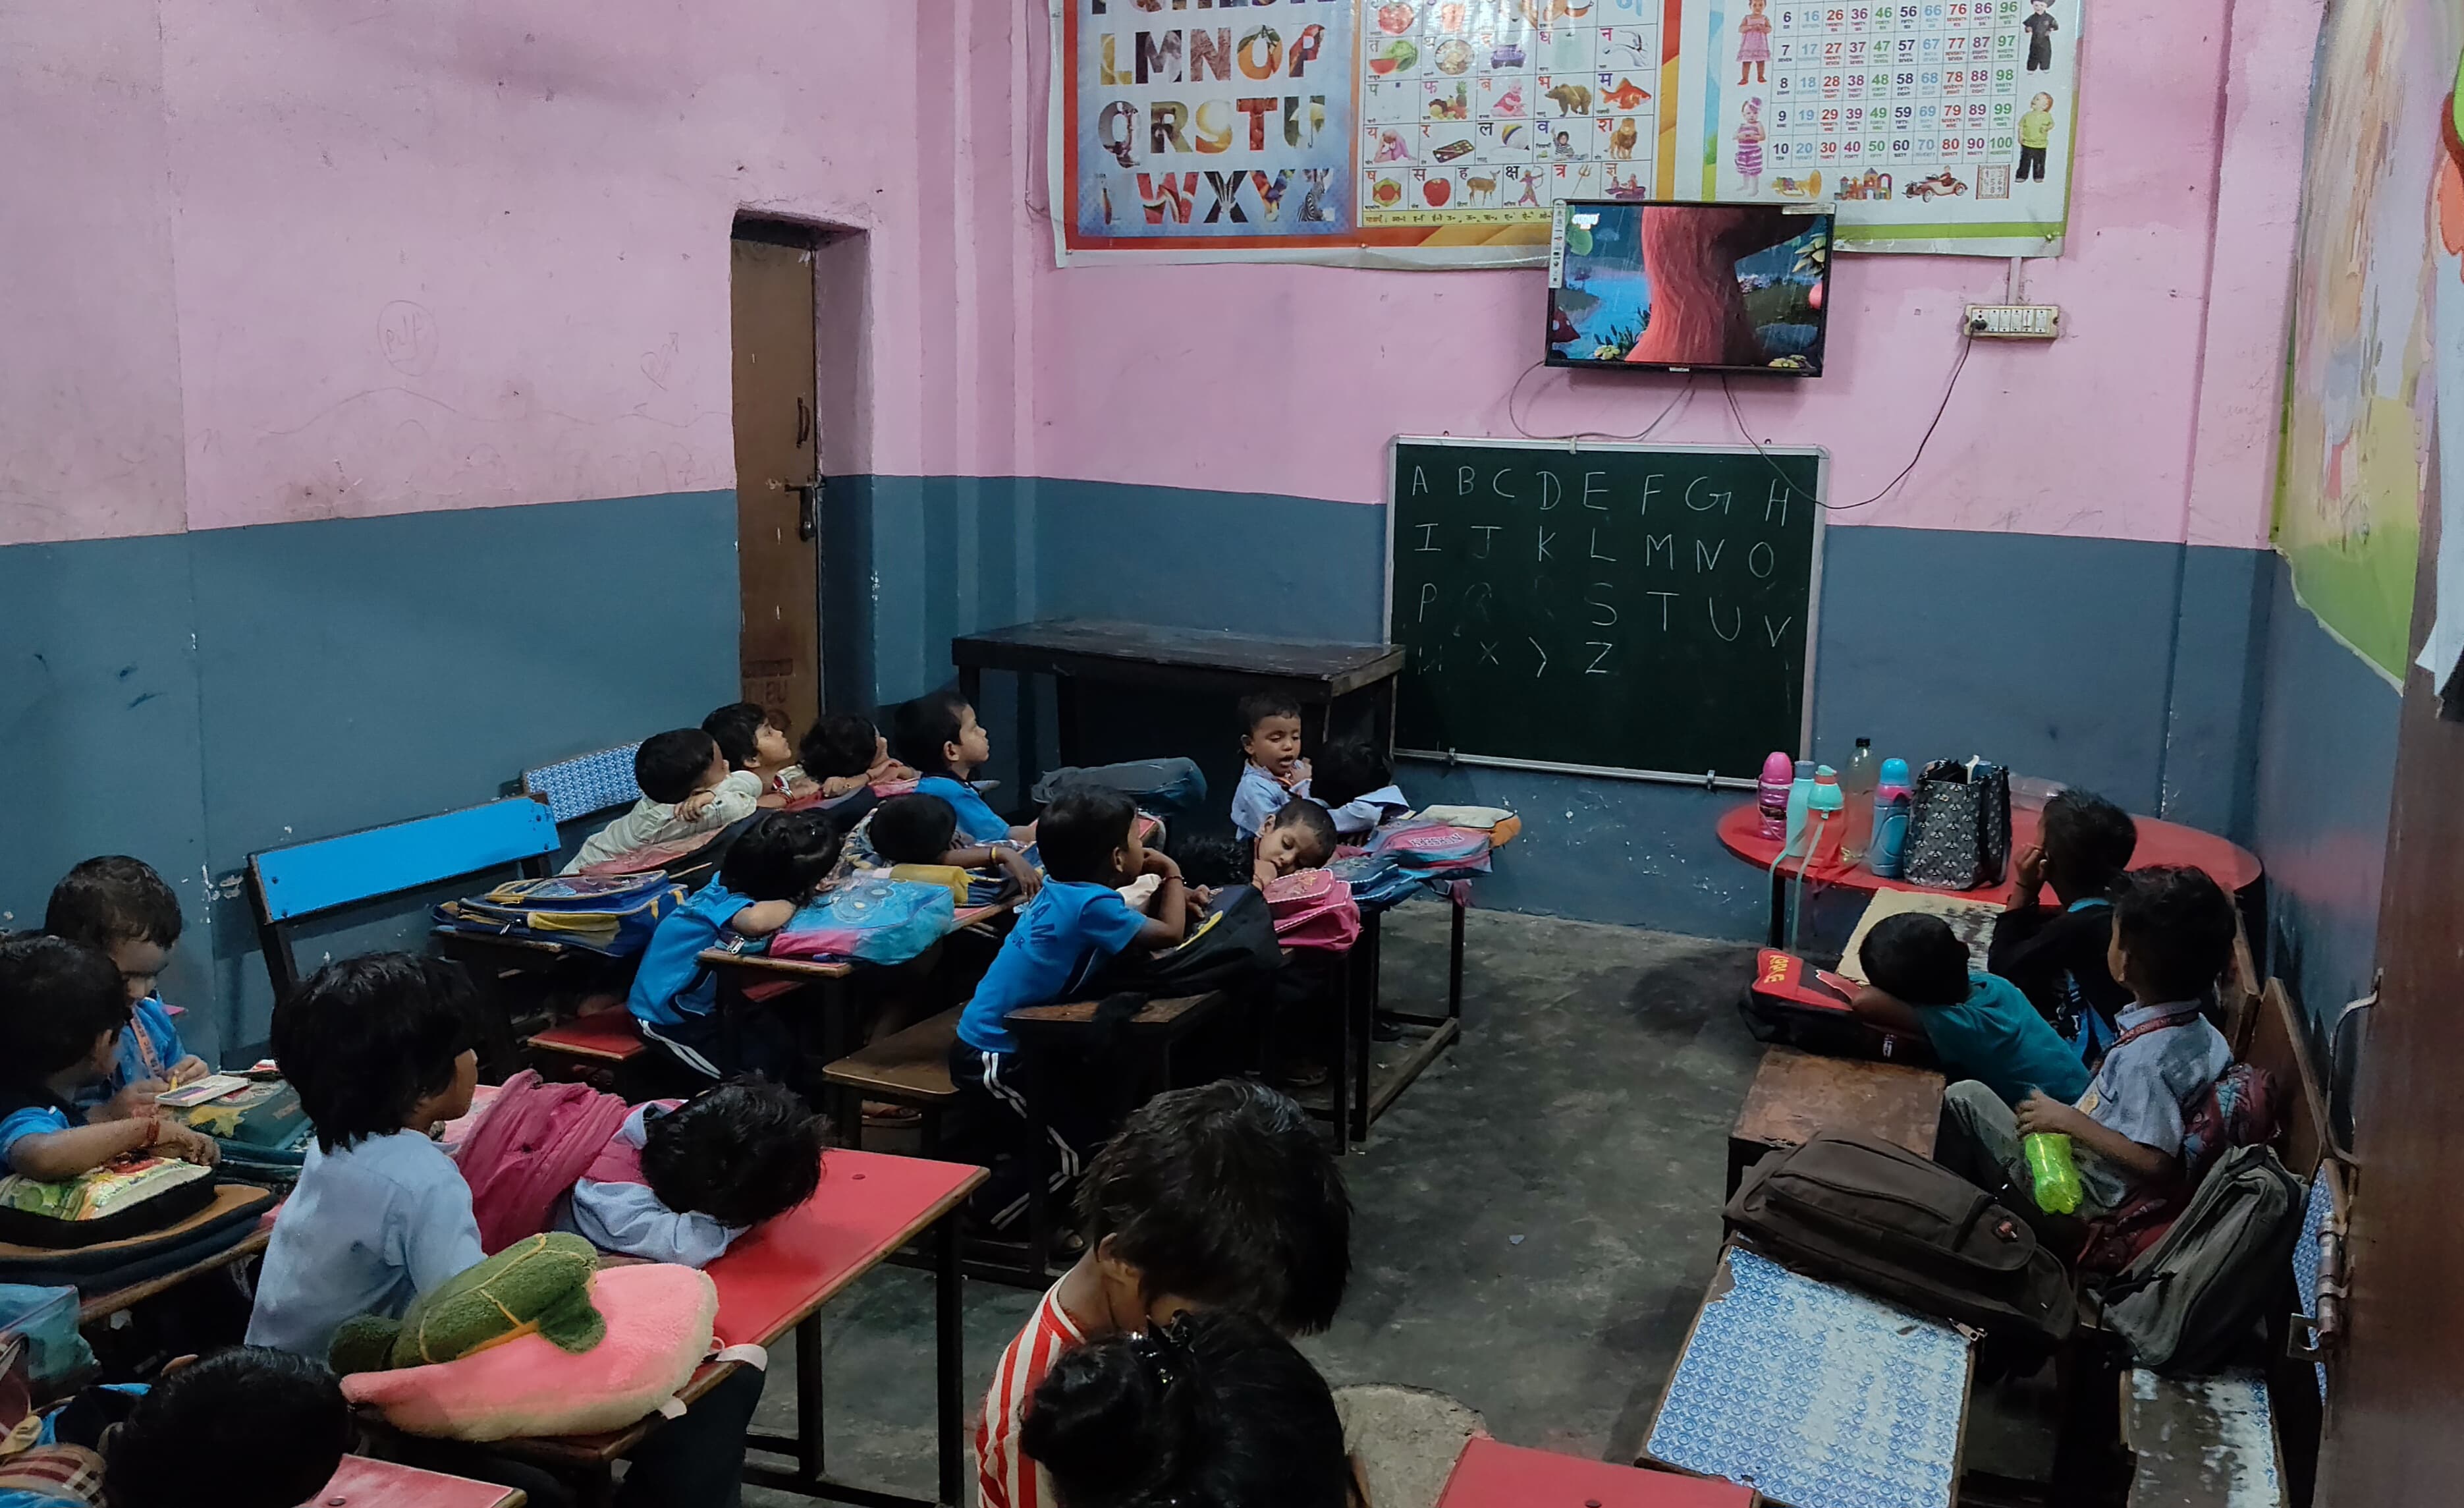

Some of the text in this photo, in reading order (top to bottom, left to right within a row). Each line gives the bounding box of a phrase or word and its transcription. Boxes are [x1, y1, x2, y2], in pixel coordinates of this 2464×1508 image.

[1784, 1, 2017, 22] 6 16 26 36 46 56 66 76 86 96
[1370, 40, 1380, 52] त
[1600, 28, 1614, 41] न
[1782, 36, 2015, 55] 7 17 27 37 47 57 67 77 87 97
[1368, 73, 1612, 96] प फ ब भ म
[1780, 69, 2013, 88] 8 18 28 38 48 58 68 78 88 98
[1779, 103, 2012, 121] 9 19 29 39 49 59 69 79 89 99
[1366, 118, 1614, 139] य र ल व श
[1773, 137, 2013, 154] 10 20 30 40 50 60 70 80 90 100
[1365, 171, 1377, 182] ष
[1412, 169, 1427, 181] स
[1458, 167, 1469, 180] ह
[1506, 166, 1520, 180] क्ष
[1554, 164, 1567, 178] त्र
[1413, 466, 1790, 526] A B C D E F G H
[1414, 524, 1774, 577] I J K L M N O
[1419, 583, 1437, 623] P
[1584, 582, 1617, 626] S
[1647, 592, 1680, 631] T
[1709, 597, 1740, 642] U
[1765, 616, 1791, 647] V
[1479, 640, 1498, 665] X
[1585, 642, 1612, 674] Z
[1409, 833, 1465, 847] NURSERY
